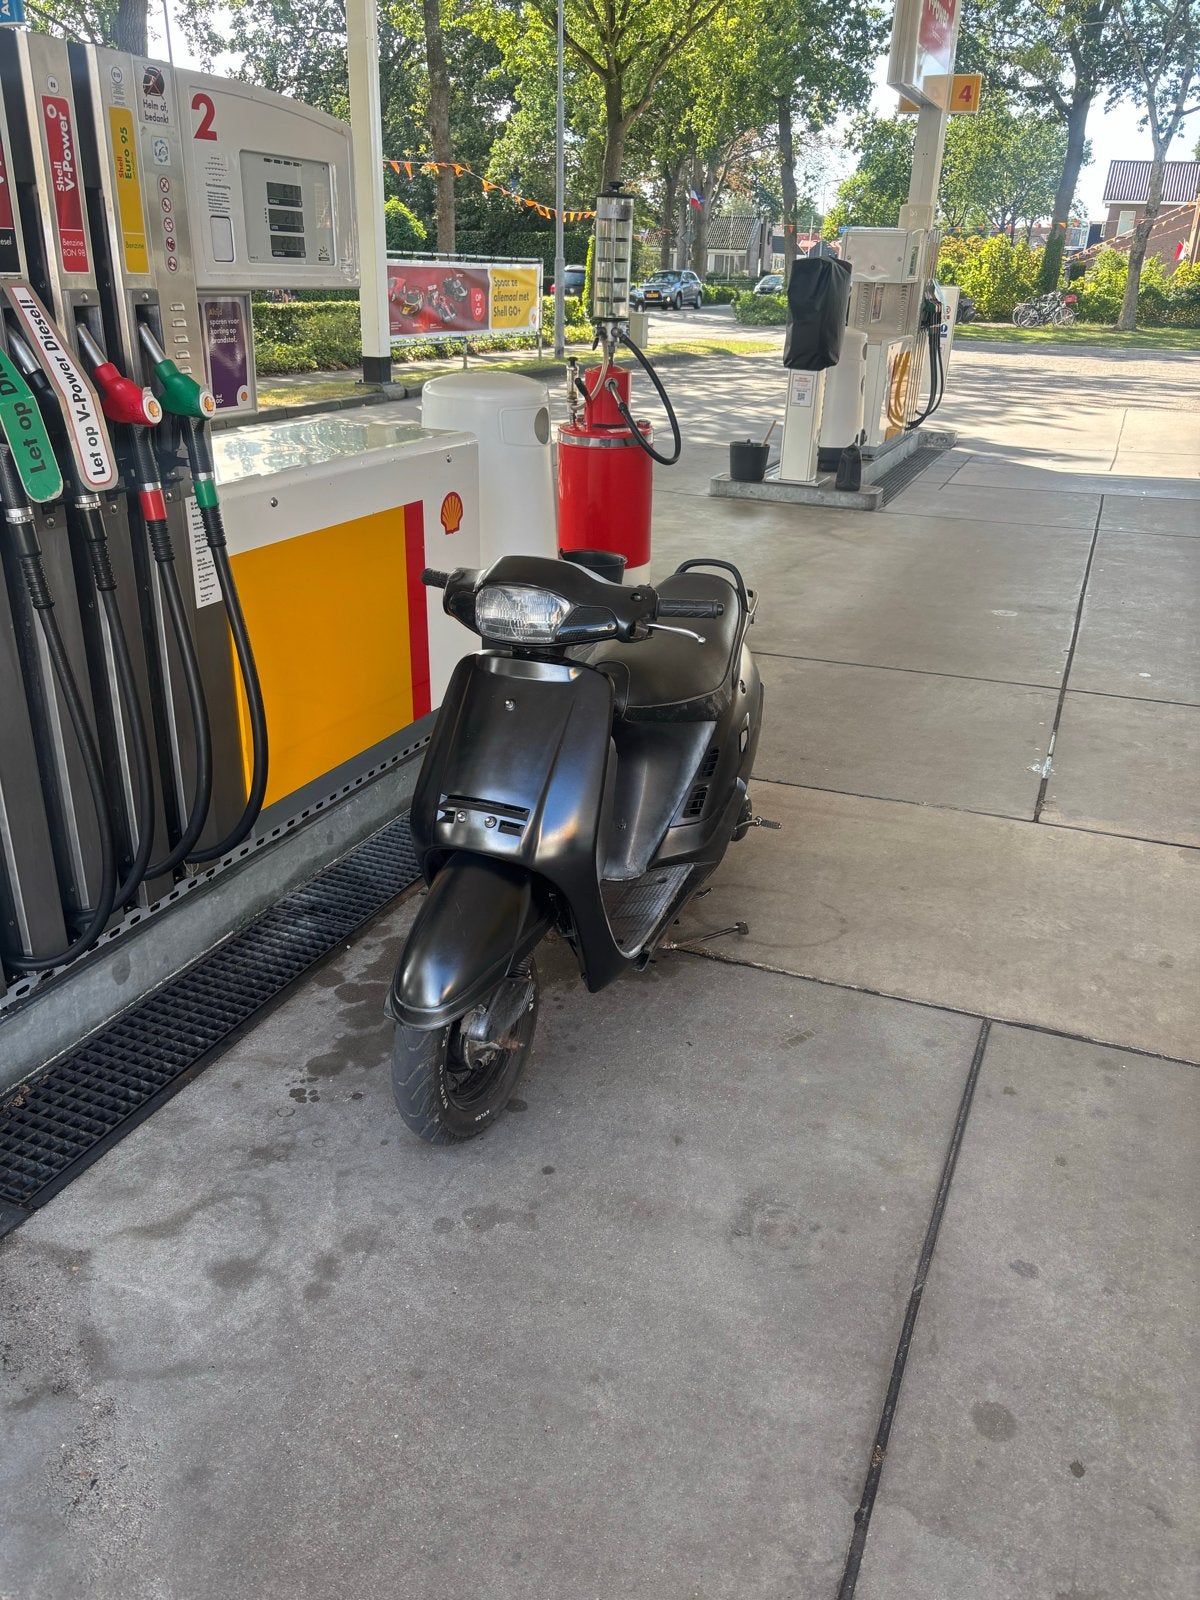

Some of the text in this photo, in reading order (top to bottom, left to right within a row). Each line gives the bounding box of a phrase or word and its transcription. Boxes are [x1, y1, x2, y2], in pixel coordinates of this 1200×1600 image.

[958, 84, 972, 102] 4
[143, 99, 159, 111] Helm
[144, 111, 169, 124] bedankt
[191, 92, 218, 141] 2
[58, 112, 75, 192] V-Power
[119, 126, 132, 179] Euro 95
[116, 156, 124, 179] Shell
[53, 161, 65, 192] Shell
[62, 238, 84, 247] Benzine
[125, 241, 145, 249] Benzine
[63, 247, 86, 257] RON 98
[493, 276, 518, 288] Spaar ze
[475, 293, 482, 302] OP
[493, 290, 529, 302] allemaal met
[475, 307, 482, 316] OP
[493, 305, 521, 317] Shell GO+
[210, 319, 227, 327] sparen
[210, 327, 230, 336] korting
[19, 299, 106, 476] Let op V-Power Diesel!
[13, 402, 33, 431] op
[23, 438, 47, 474] Let
